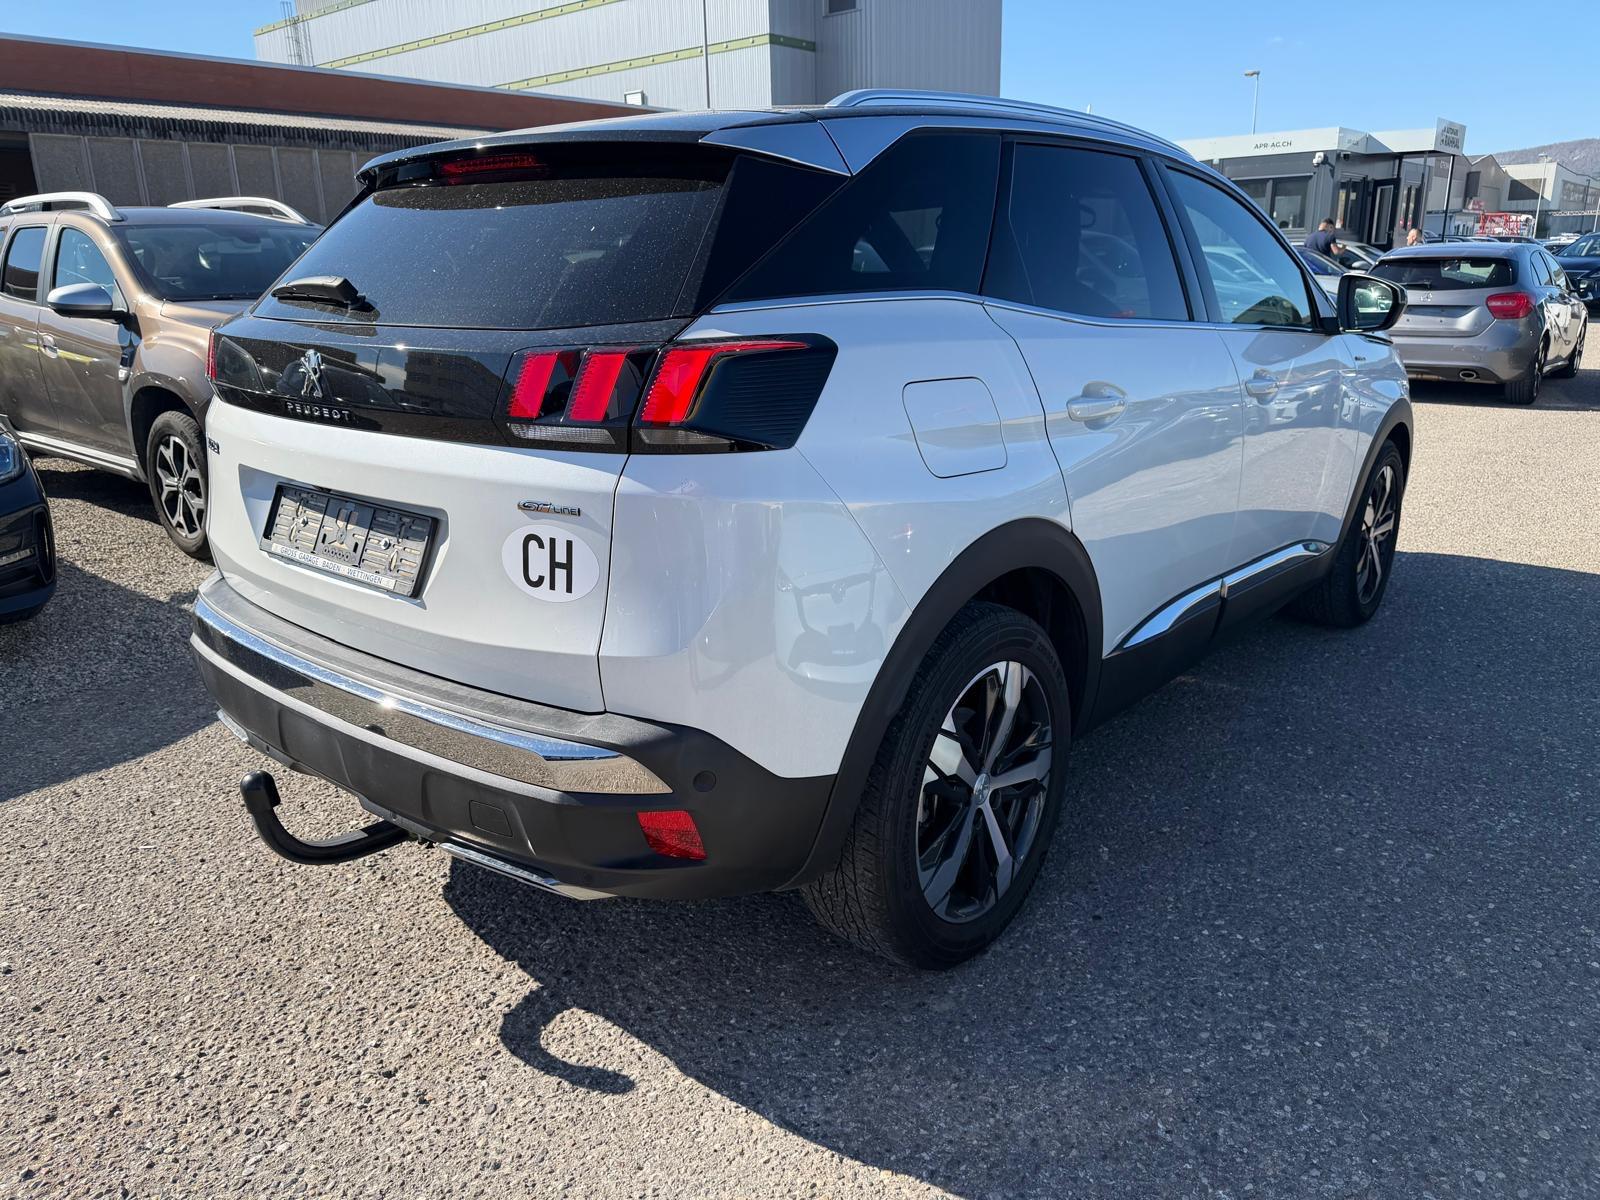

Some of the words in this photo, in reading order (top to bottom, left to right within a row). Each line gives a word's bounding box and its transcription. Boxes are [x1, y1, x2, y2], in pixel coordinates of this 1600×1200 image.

[286, 402, 350, 420] PEUGEOT
[280, 547, 297, 557] GROSS
[299, 552, 319, 565] GARAGE
[322, 560, 341, 572] BADEN
[346, 569, 383, 585] WETTINGEN
[522, 533, 573, 593] CH
